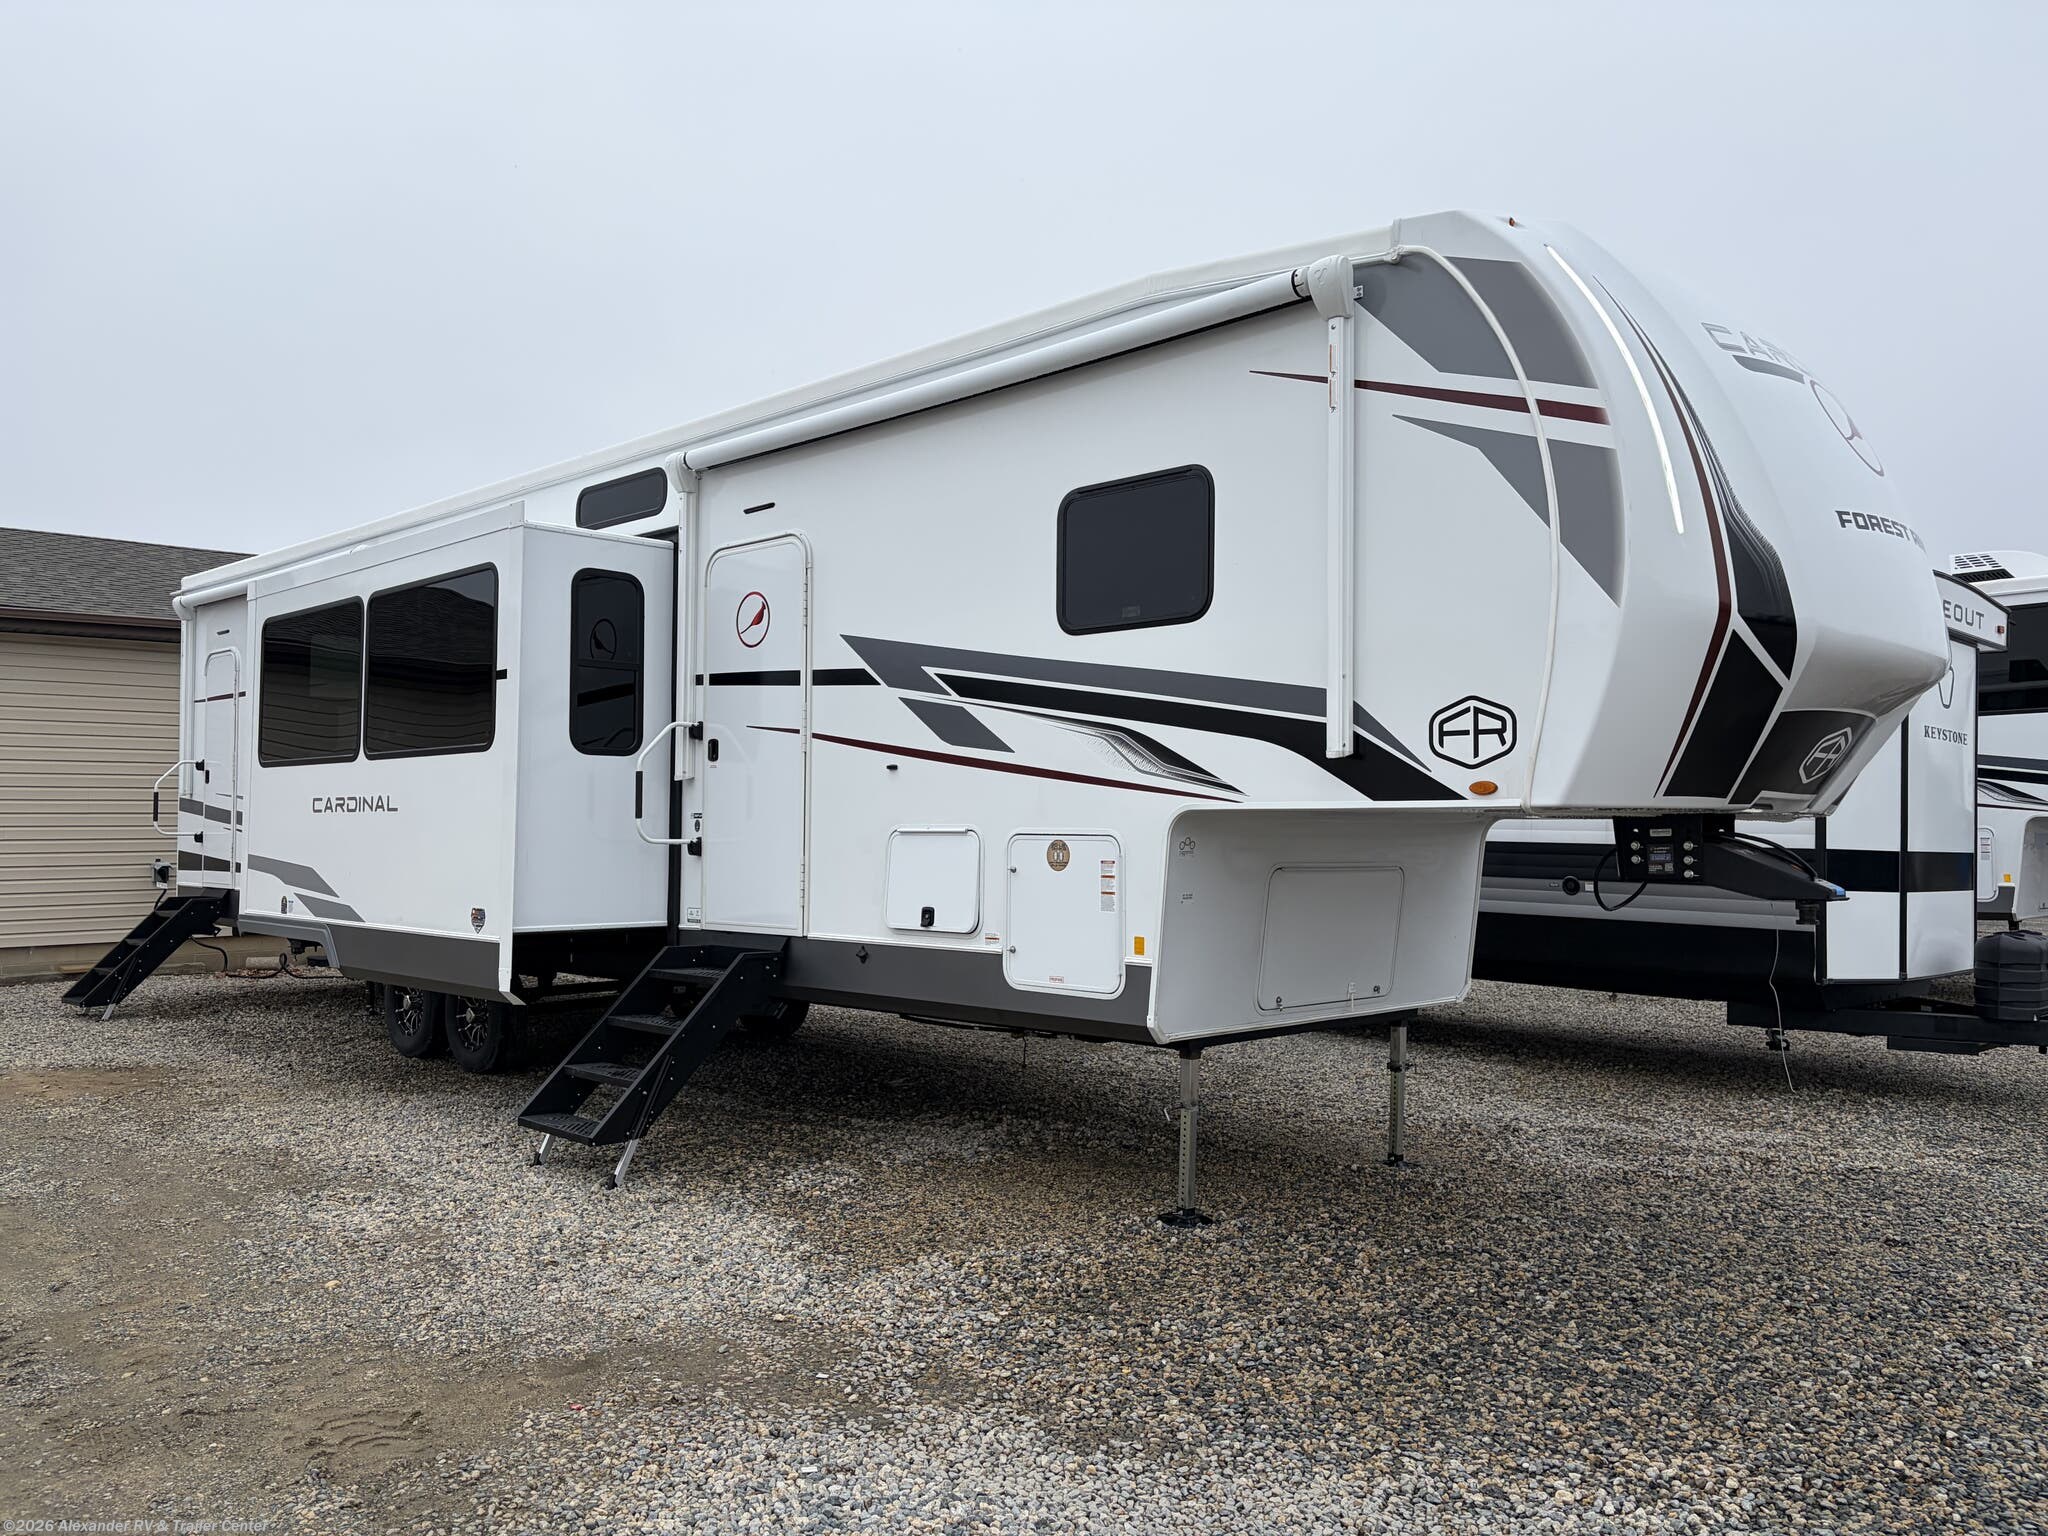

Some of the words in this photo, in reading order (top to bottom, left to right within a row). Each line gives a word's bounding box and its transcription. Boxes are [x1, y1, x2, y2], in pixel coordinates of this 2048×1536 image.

[1835, 510, 1910, 541] FOREST
[1437, 705, 1508, 759] FR
[1923, 725, 1969, 746] KEYSTONE
[312, 795, 399, 813] CARDINAL
